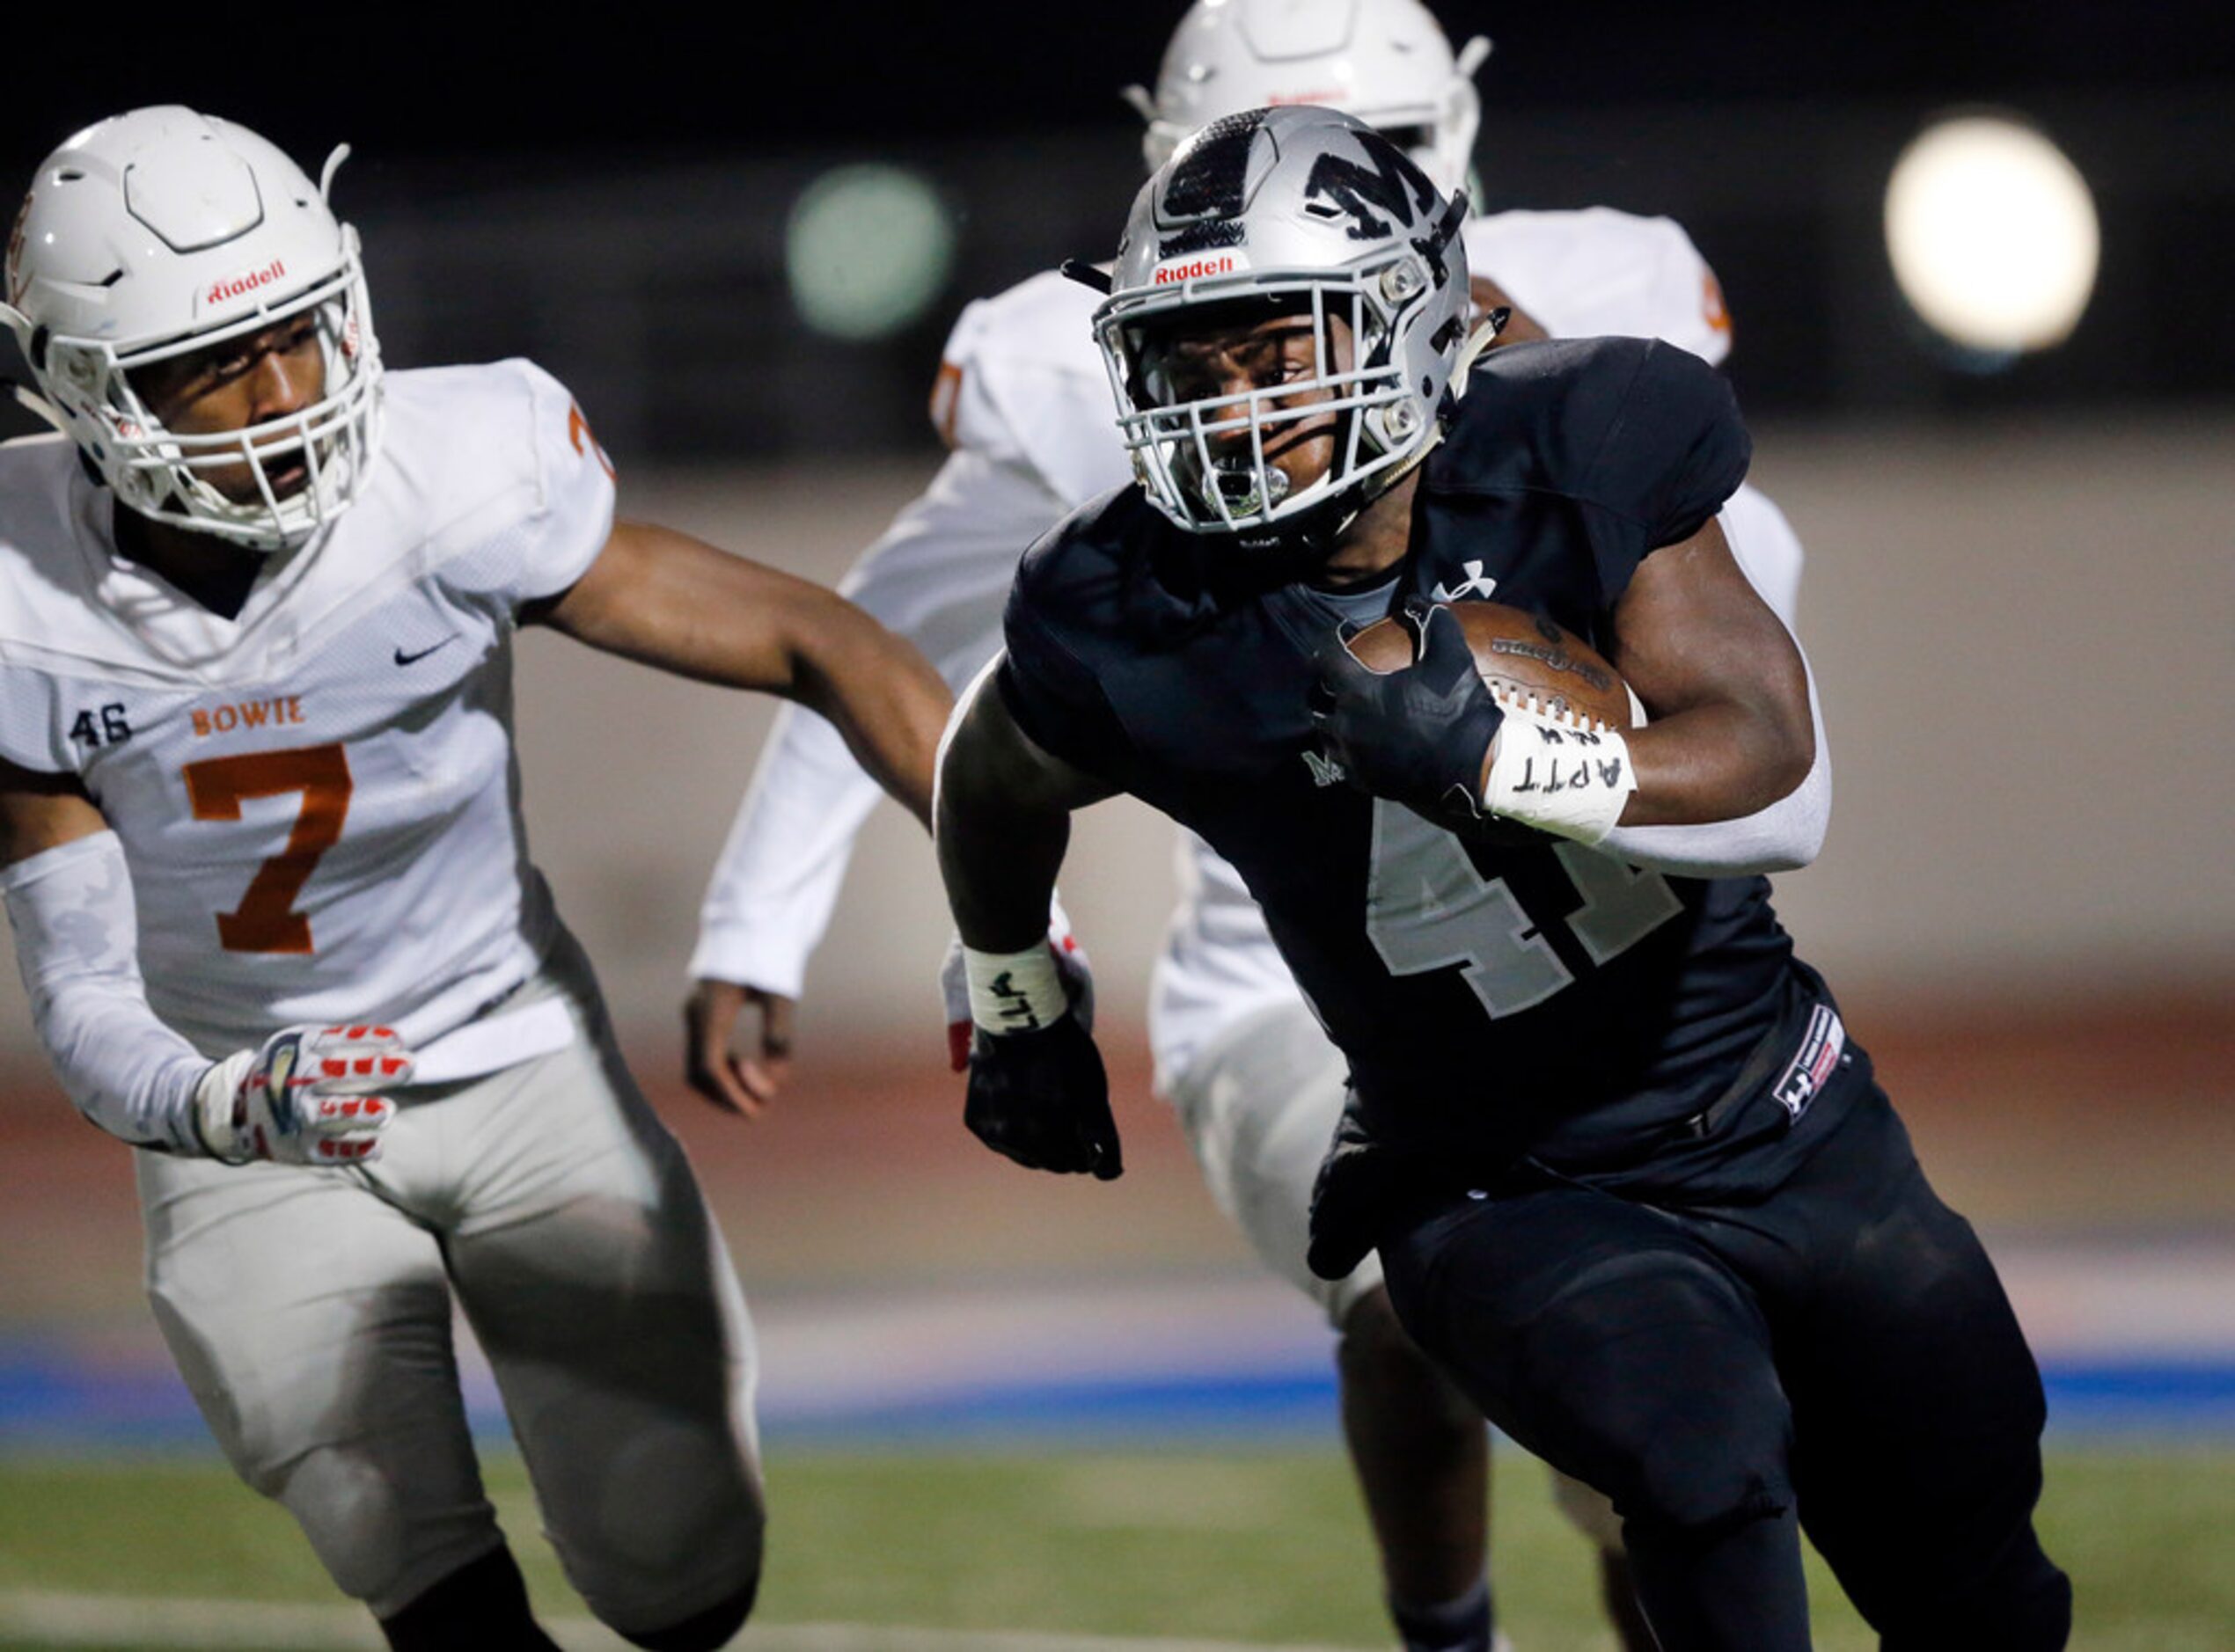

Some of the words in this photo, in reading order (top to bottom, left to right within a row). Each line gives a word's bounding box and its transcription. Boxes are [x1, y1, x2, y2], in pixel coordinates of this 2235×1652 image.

[208, 259, 285, 303] Riddell
[1155, 257, 1233, 285] Riddell
[70, 702, 132, 747] 46
[190, 695, 305, 737] BOWIE
[182, 742, 354, 954] 7
